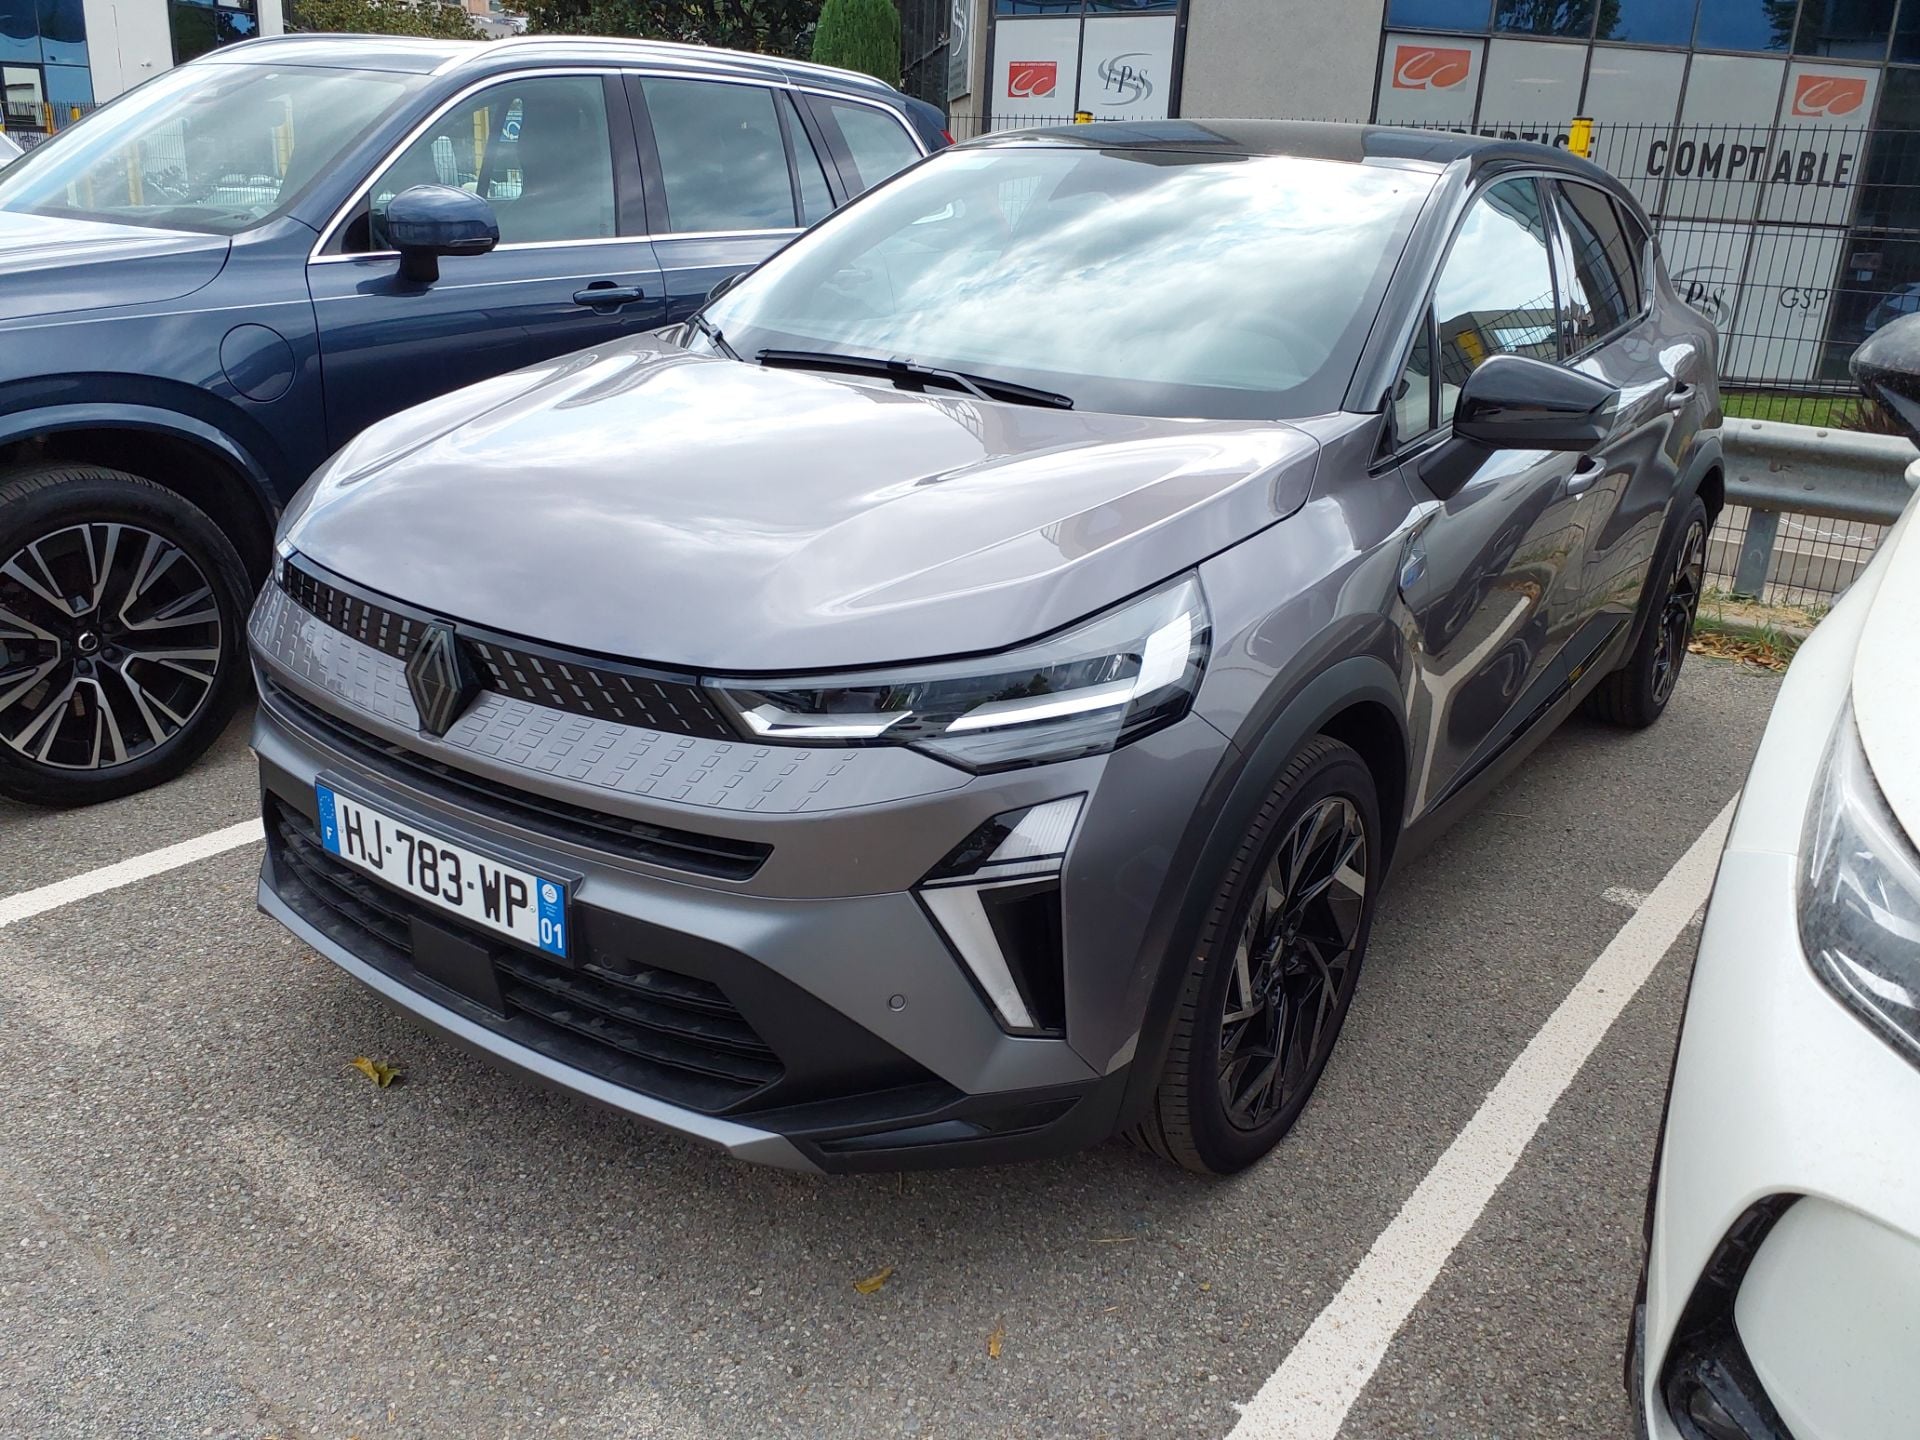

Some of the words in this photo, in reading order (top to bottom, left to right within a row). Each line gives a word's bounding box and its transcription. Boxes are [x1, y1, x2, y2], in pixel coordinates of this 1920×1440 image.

[1646, 140, 1853, 189] COMPTABLE
[1780, 287, 1828, 310] GSP
[326, 825, 333, 840] F
[343, 804, 528, 928] HJ-783-WP
[541, 917, 563, 949] 01
